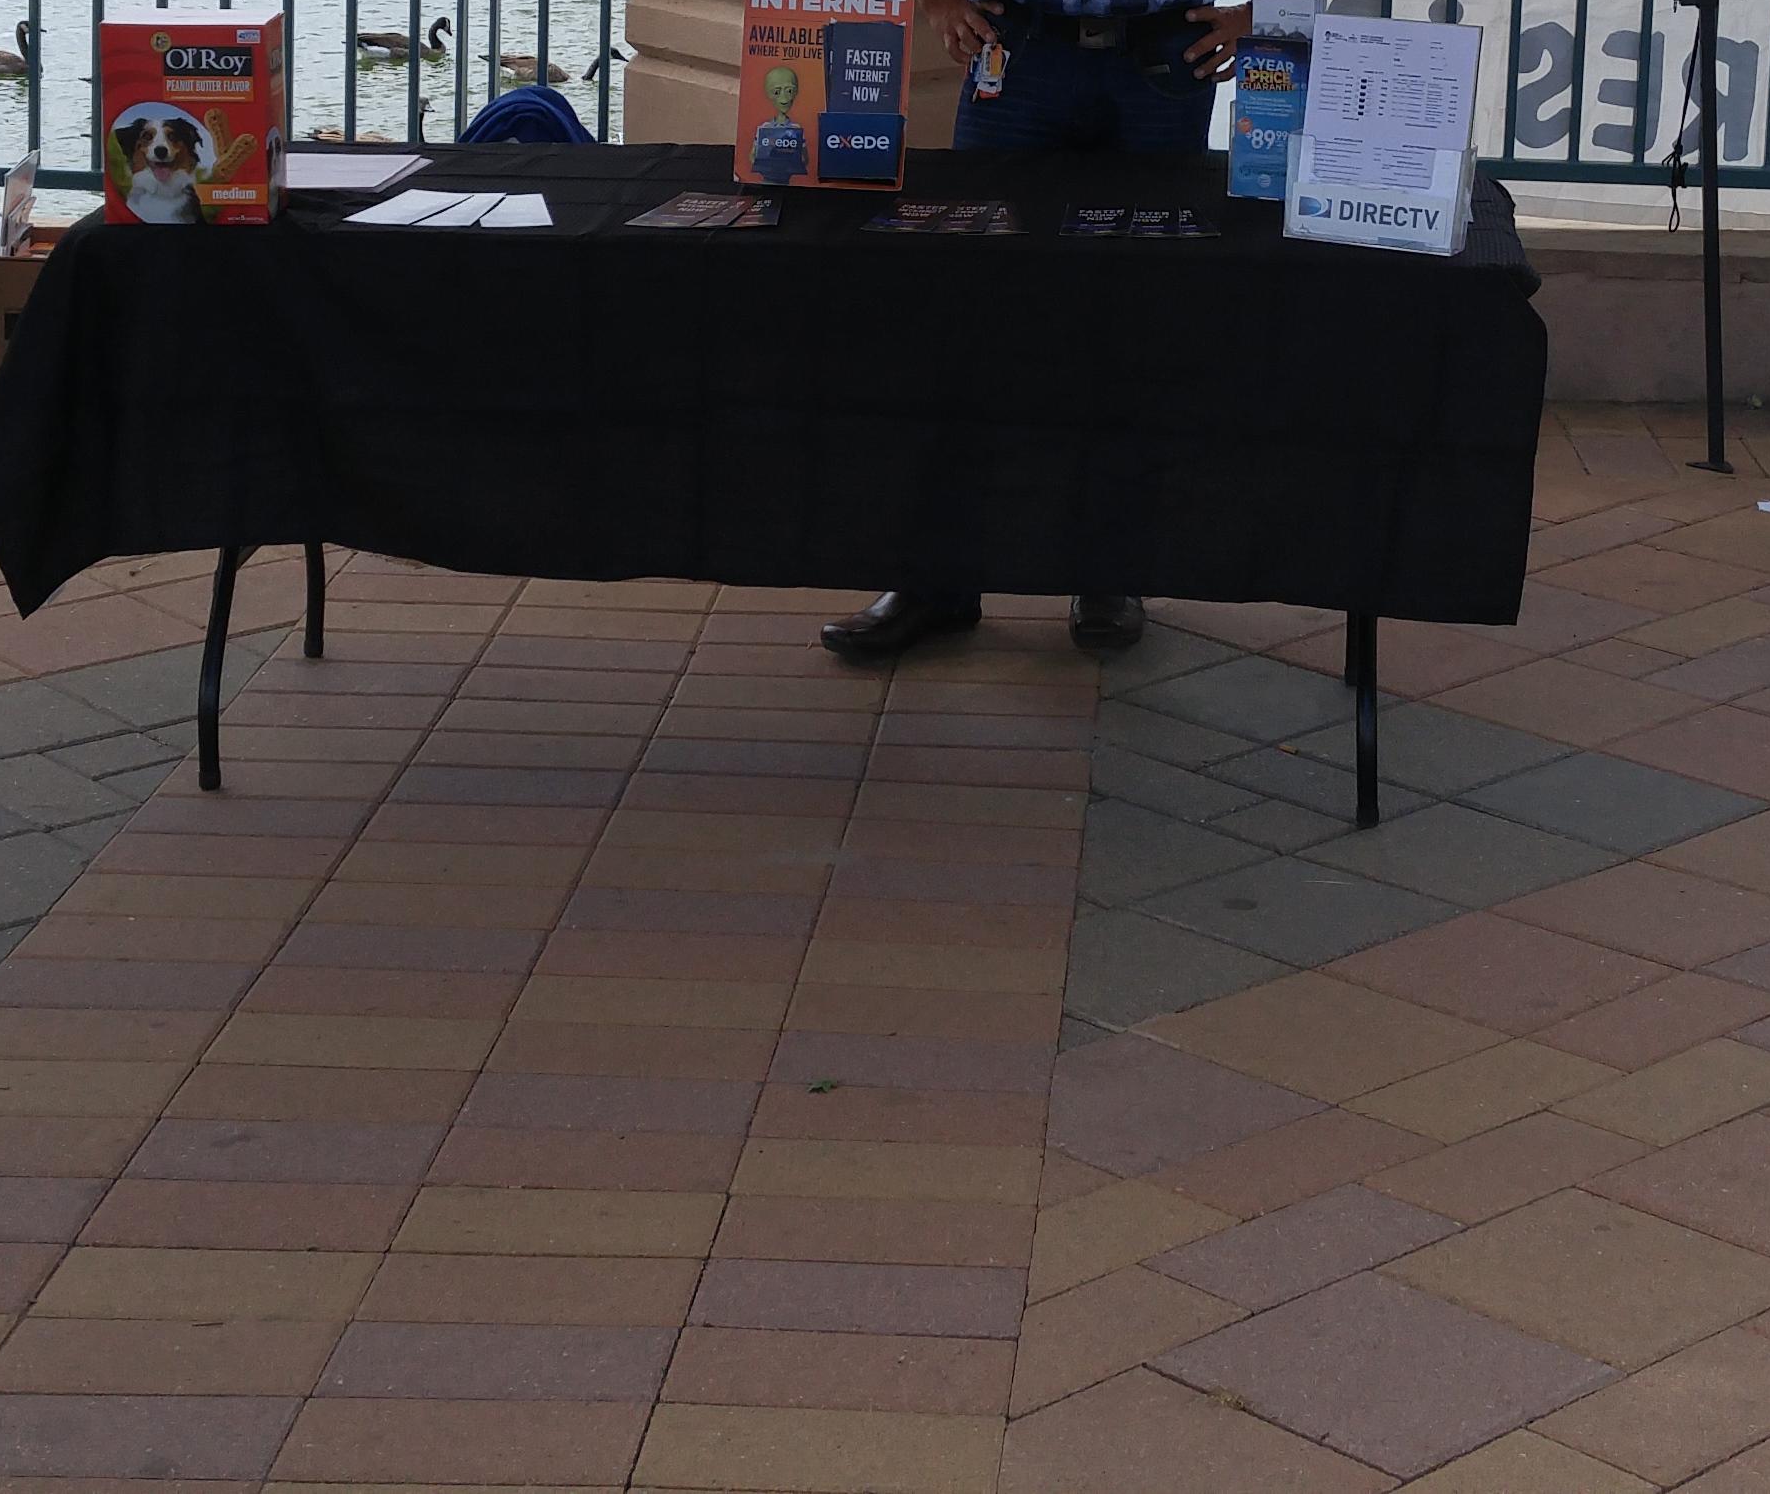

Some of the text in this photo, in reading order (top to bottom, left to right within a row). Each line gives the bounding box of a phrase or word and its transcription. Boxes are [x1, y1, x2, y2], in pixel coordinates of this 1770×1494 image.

[749, 25, 823, 45] AVAILABLE
[749, 44, 823, 59] WHERE YOU LIVE
[845, 49, 891, 66] FASTER
[845, 69, 890, 83] INTERNET
[1249, 69, 1290, 84] PRICE
[166, 79, 250, 92] PEANUT BUTTER FLAVOR
[852, 86, 880, 102] NOW
[213, 187, 257, 200] medium
[1339, 199, 1440, 230] DIRECTV
